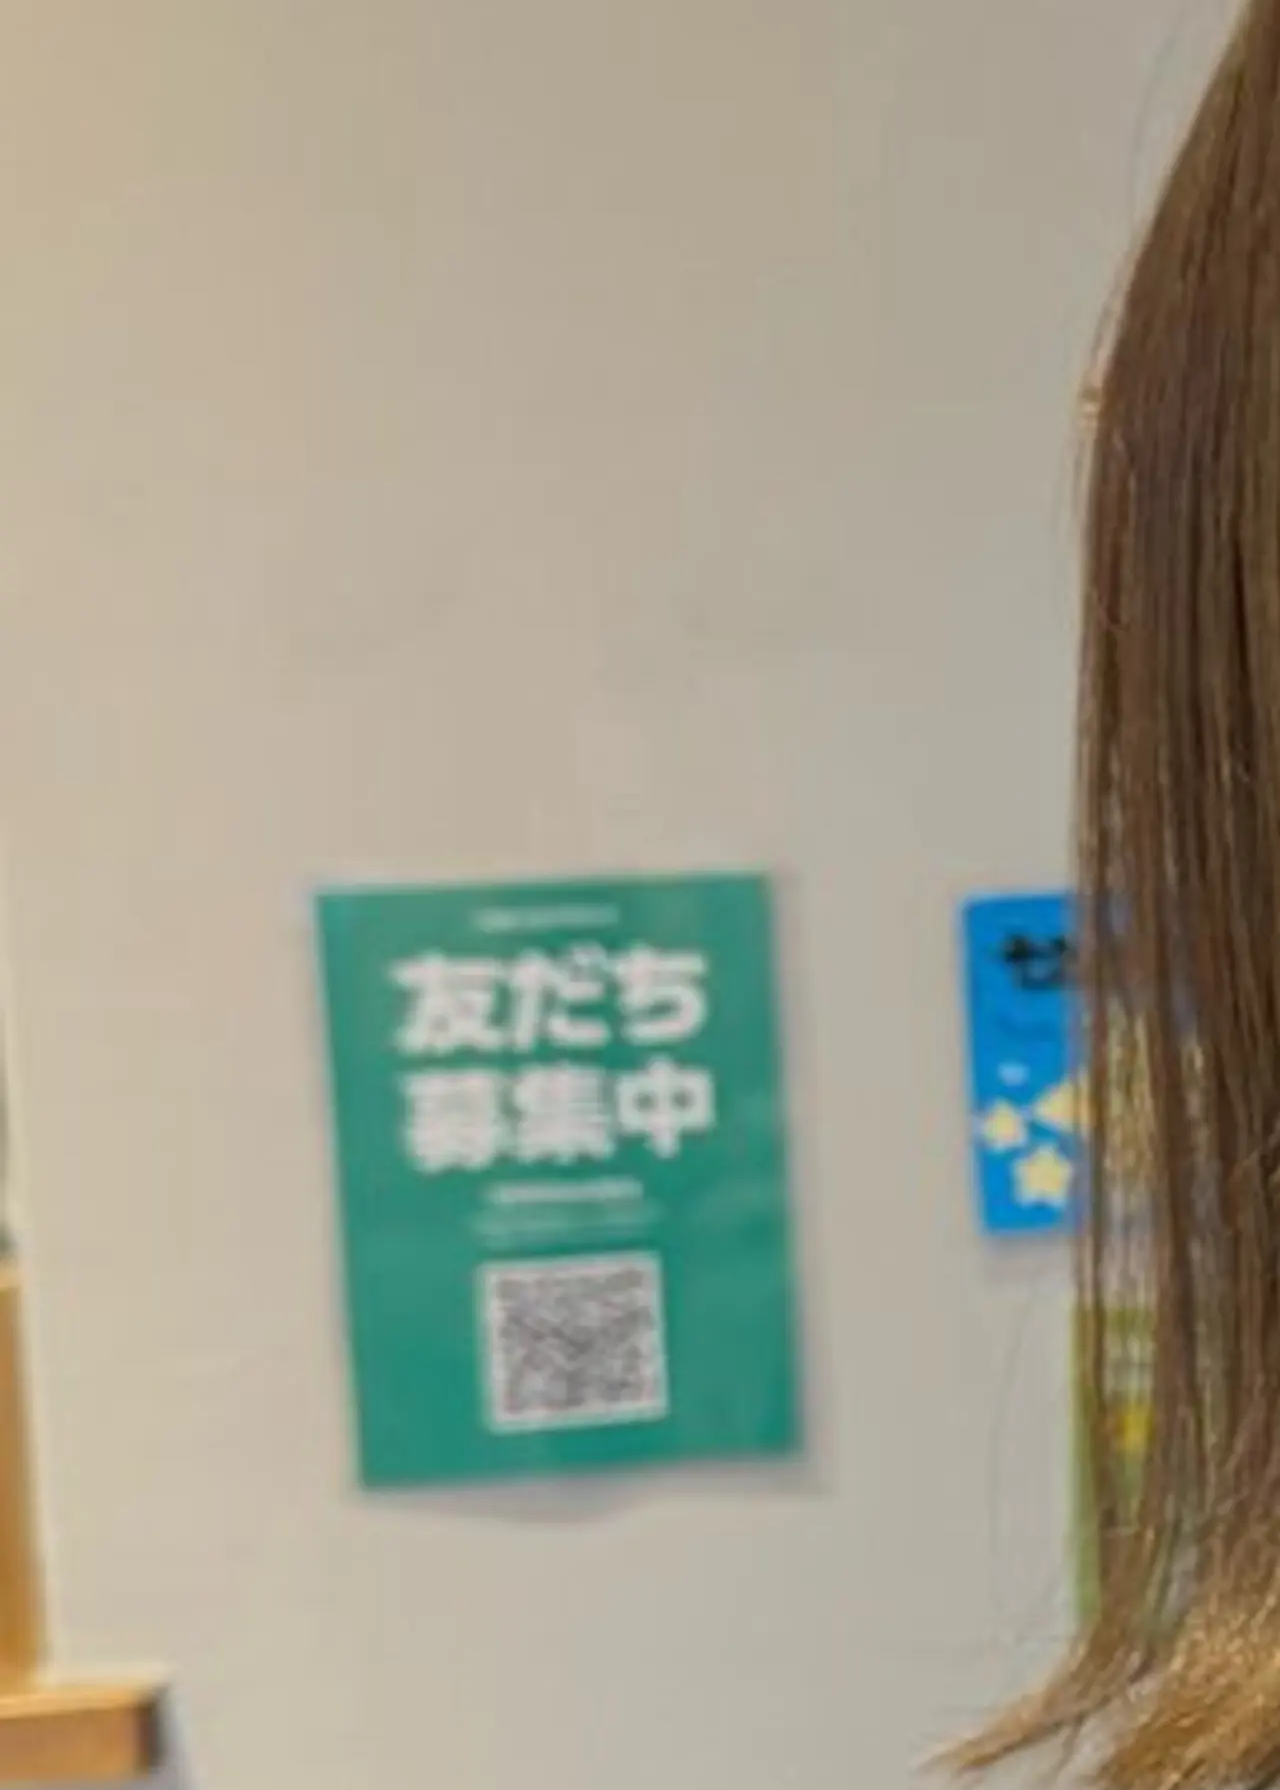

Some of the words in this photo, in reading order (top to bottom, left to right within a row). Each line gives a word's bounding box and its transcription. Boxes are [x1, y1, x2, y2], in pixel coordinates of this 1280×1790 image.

[391, 947, 705, 1053] 友だち
[404, 1059, 715, 1170] 募集中
